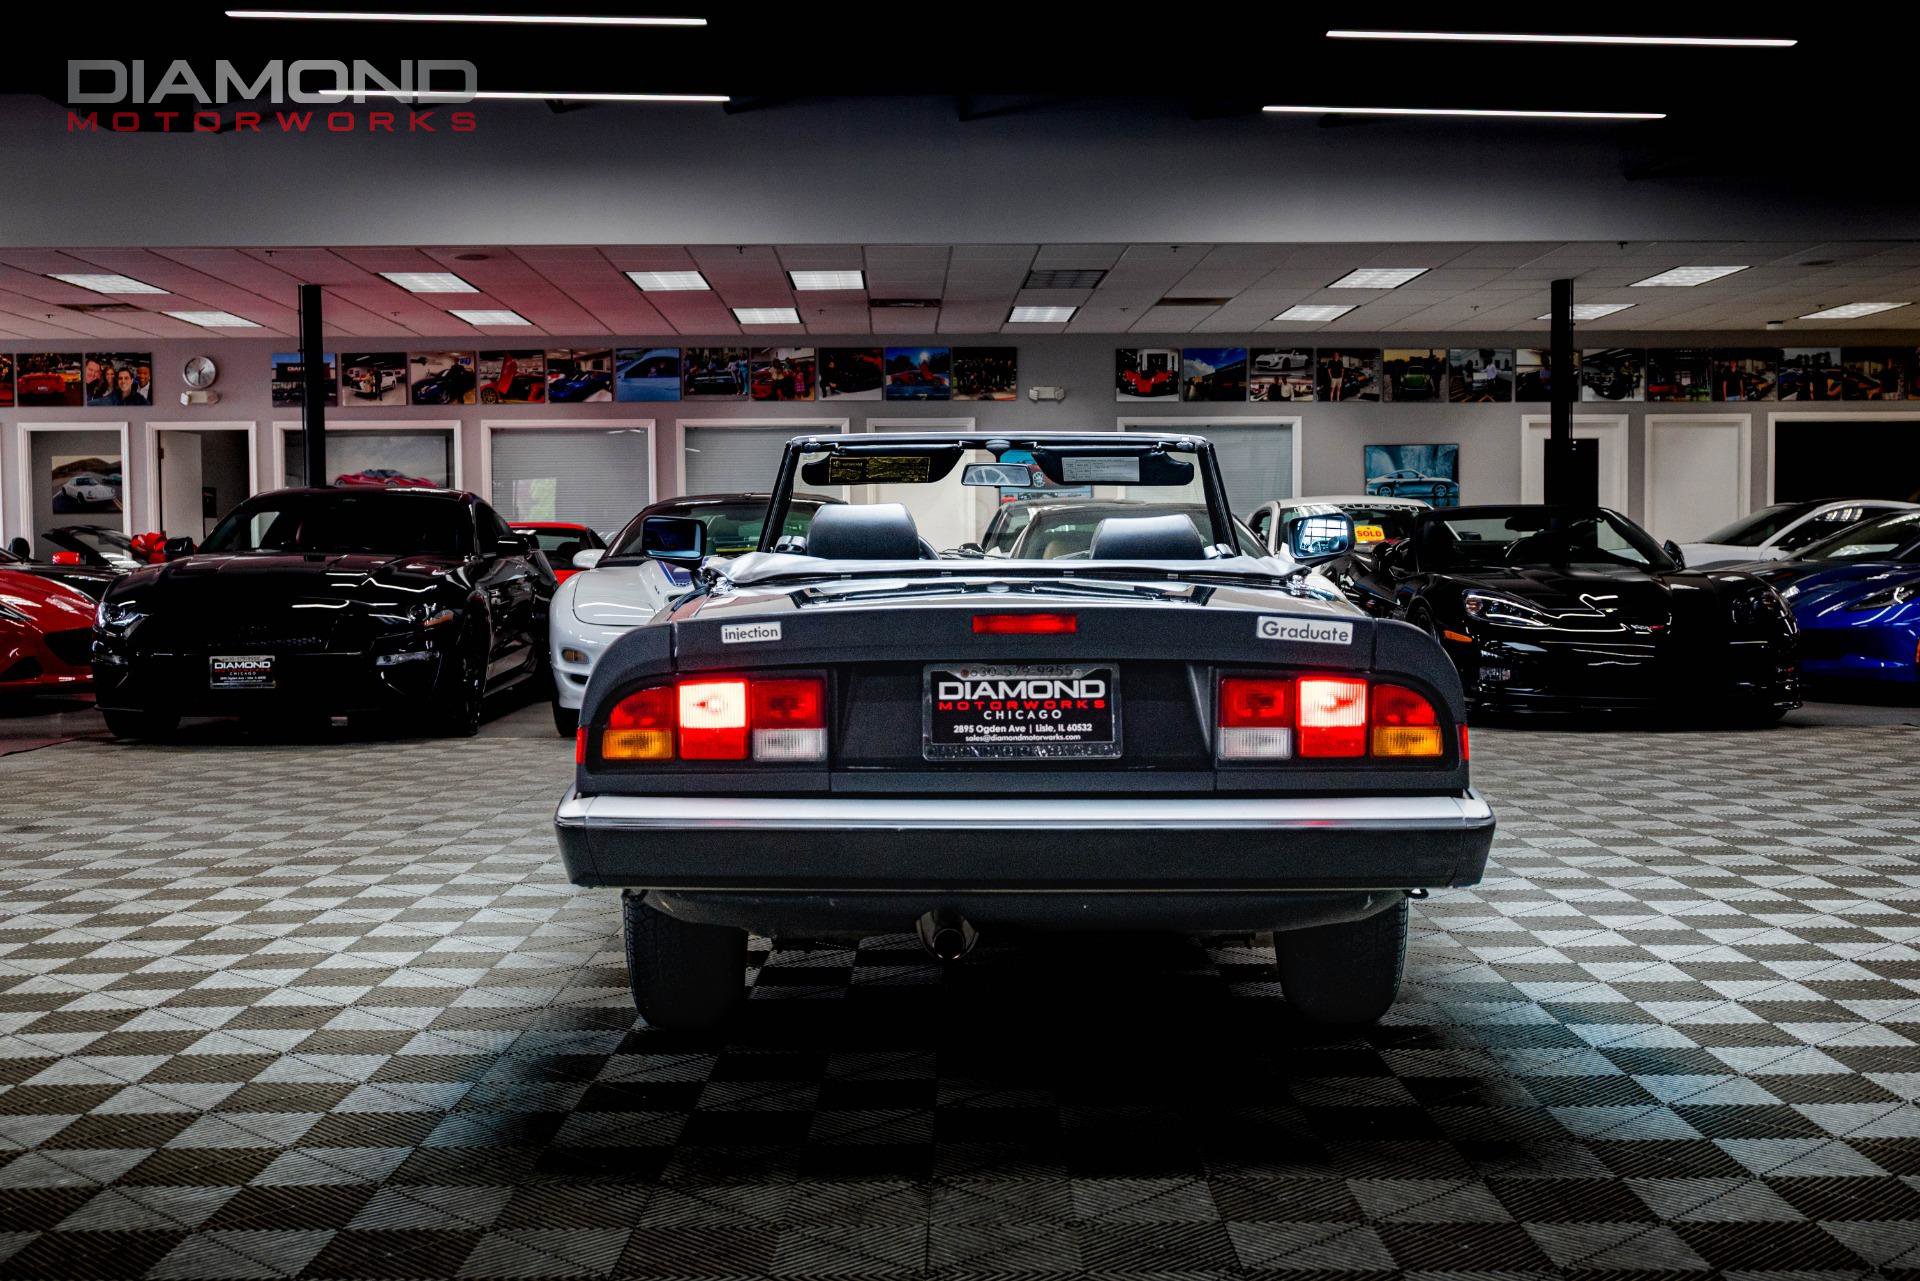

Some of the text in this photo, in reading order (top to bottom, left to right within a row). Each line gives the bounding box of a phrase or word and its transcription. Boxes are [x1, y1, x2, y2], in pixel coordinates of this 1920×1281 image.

[724, 626, 778, 640] injection
[1262, 620, 1349, 642] Graduate
[214, 661, 271, 669] DIAMOND
[938, 679, 1106, 700] DIAMOND
[938, 700, 1106, 711] MOTORWORKS
[983, 710, 1062, 720] CHICAGO
[953, 724, 975, 734] 2895
[975, 723, 1007, 735] Ogden
[1008, 723, 1027, 733] Ave
[1057, 723, 1066, 732] IL
[1066, 722, 1093, 732] 60532
[965, 733, 1081, 743] sales@diamondmotorworks.com
